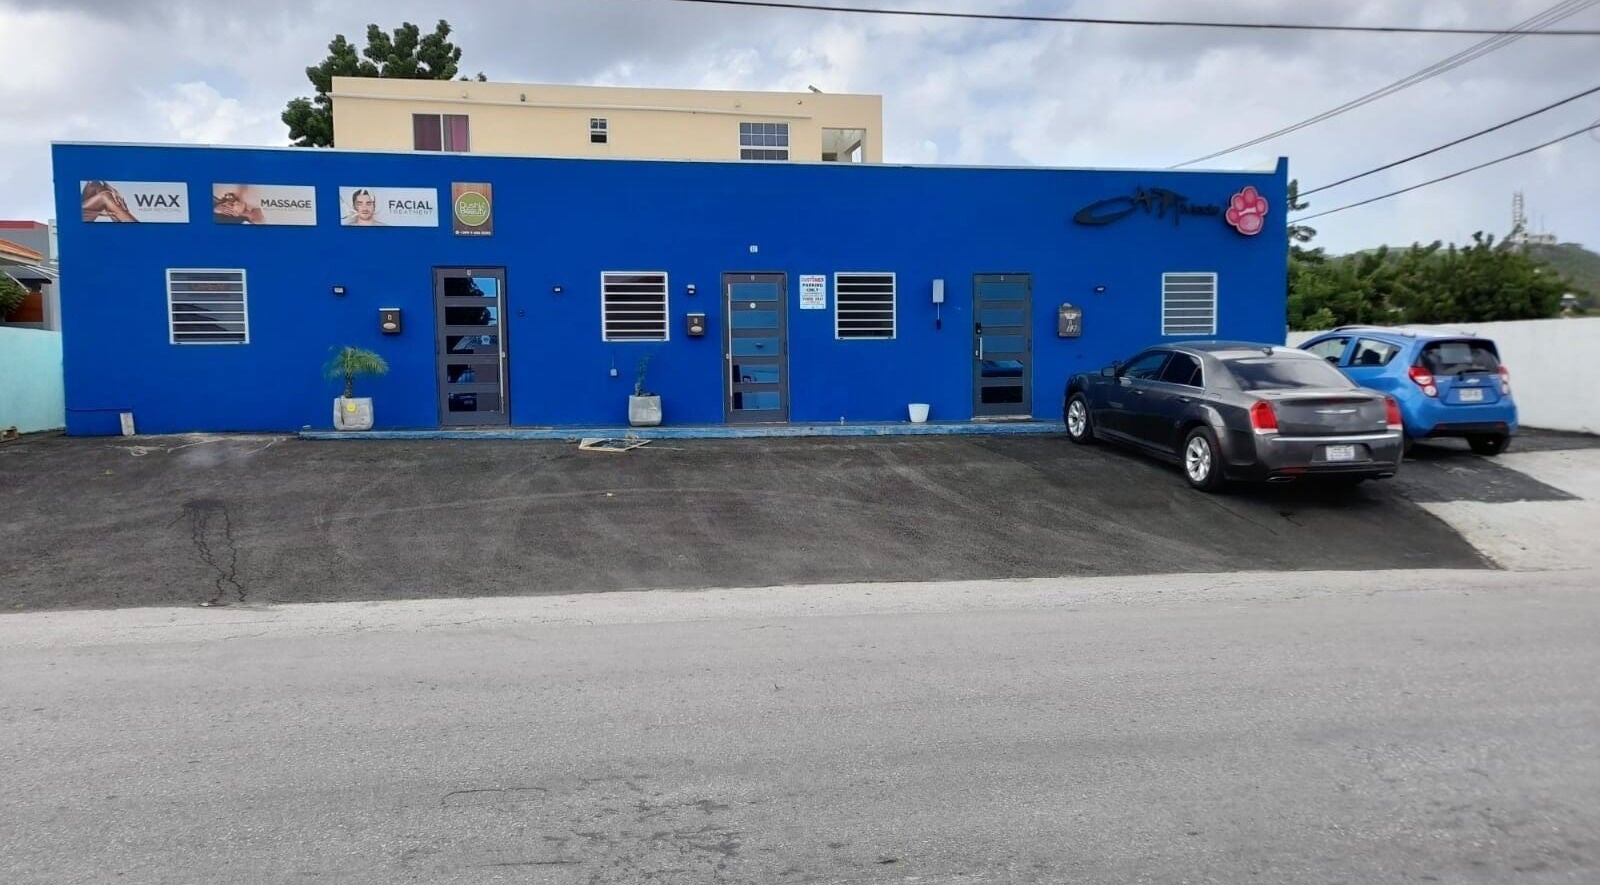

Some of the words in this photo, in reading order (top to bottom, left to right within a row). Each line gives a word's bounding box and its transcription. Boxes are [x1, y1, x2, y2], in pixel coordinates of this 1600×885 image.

[134, 194, 180, 207] WAX
[260, 199, 312, 209] MASSAGE
[388, 200, 433, 210] FACIAL
